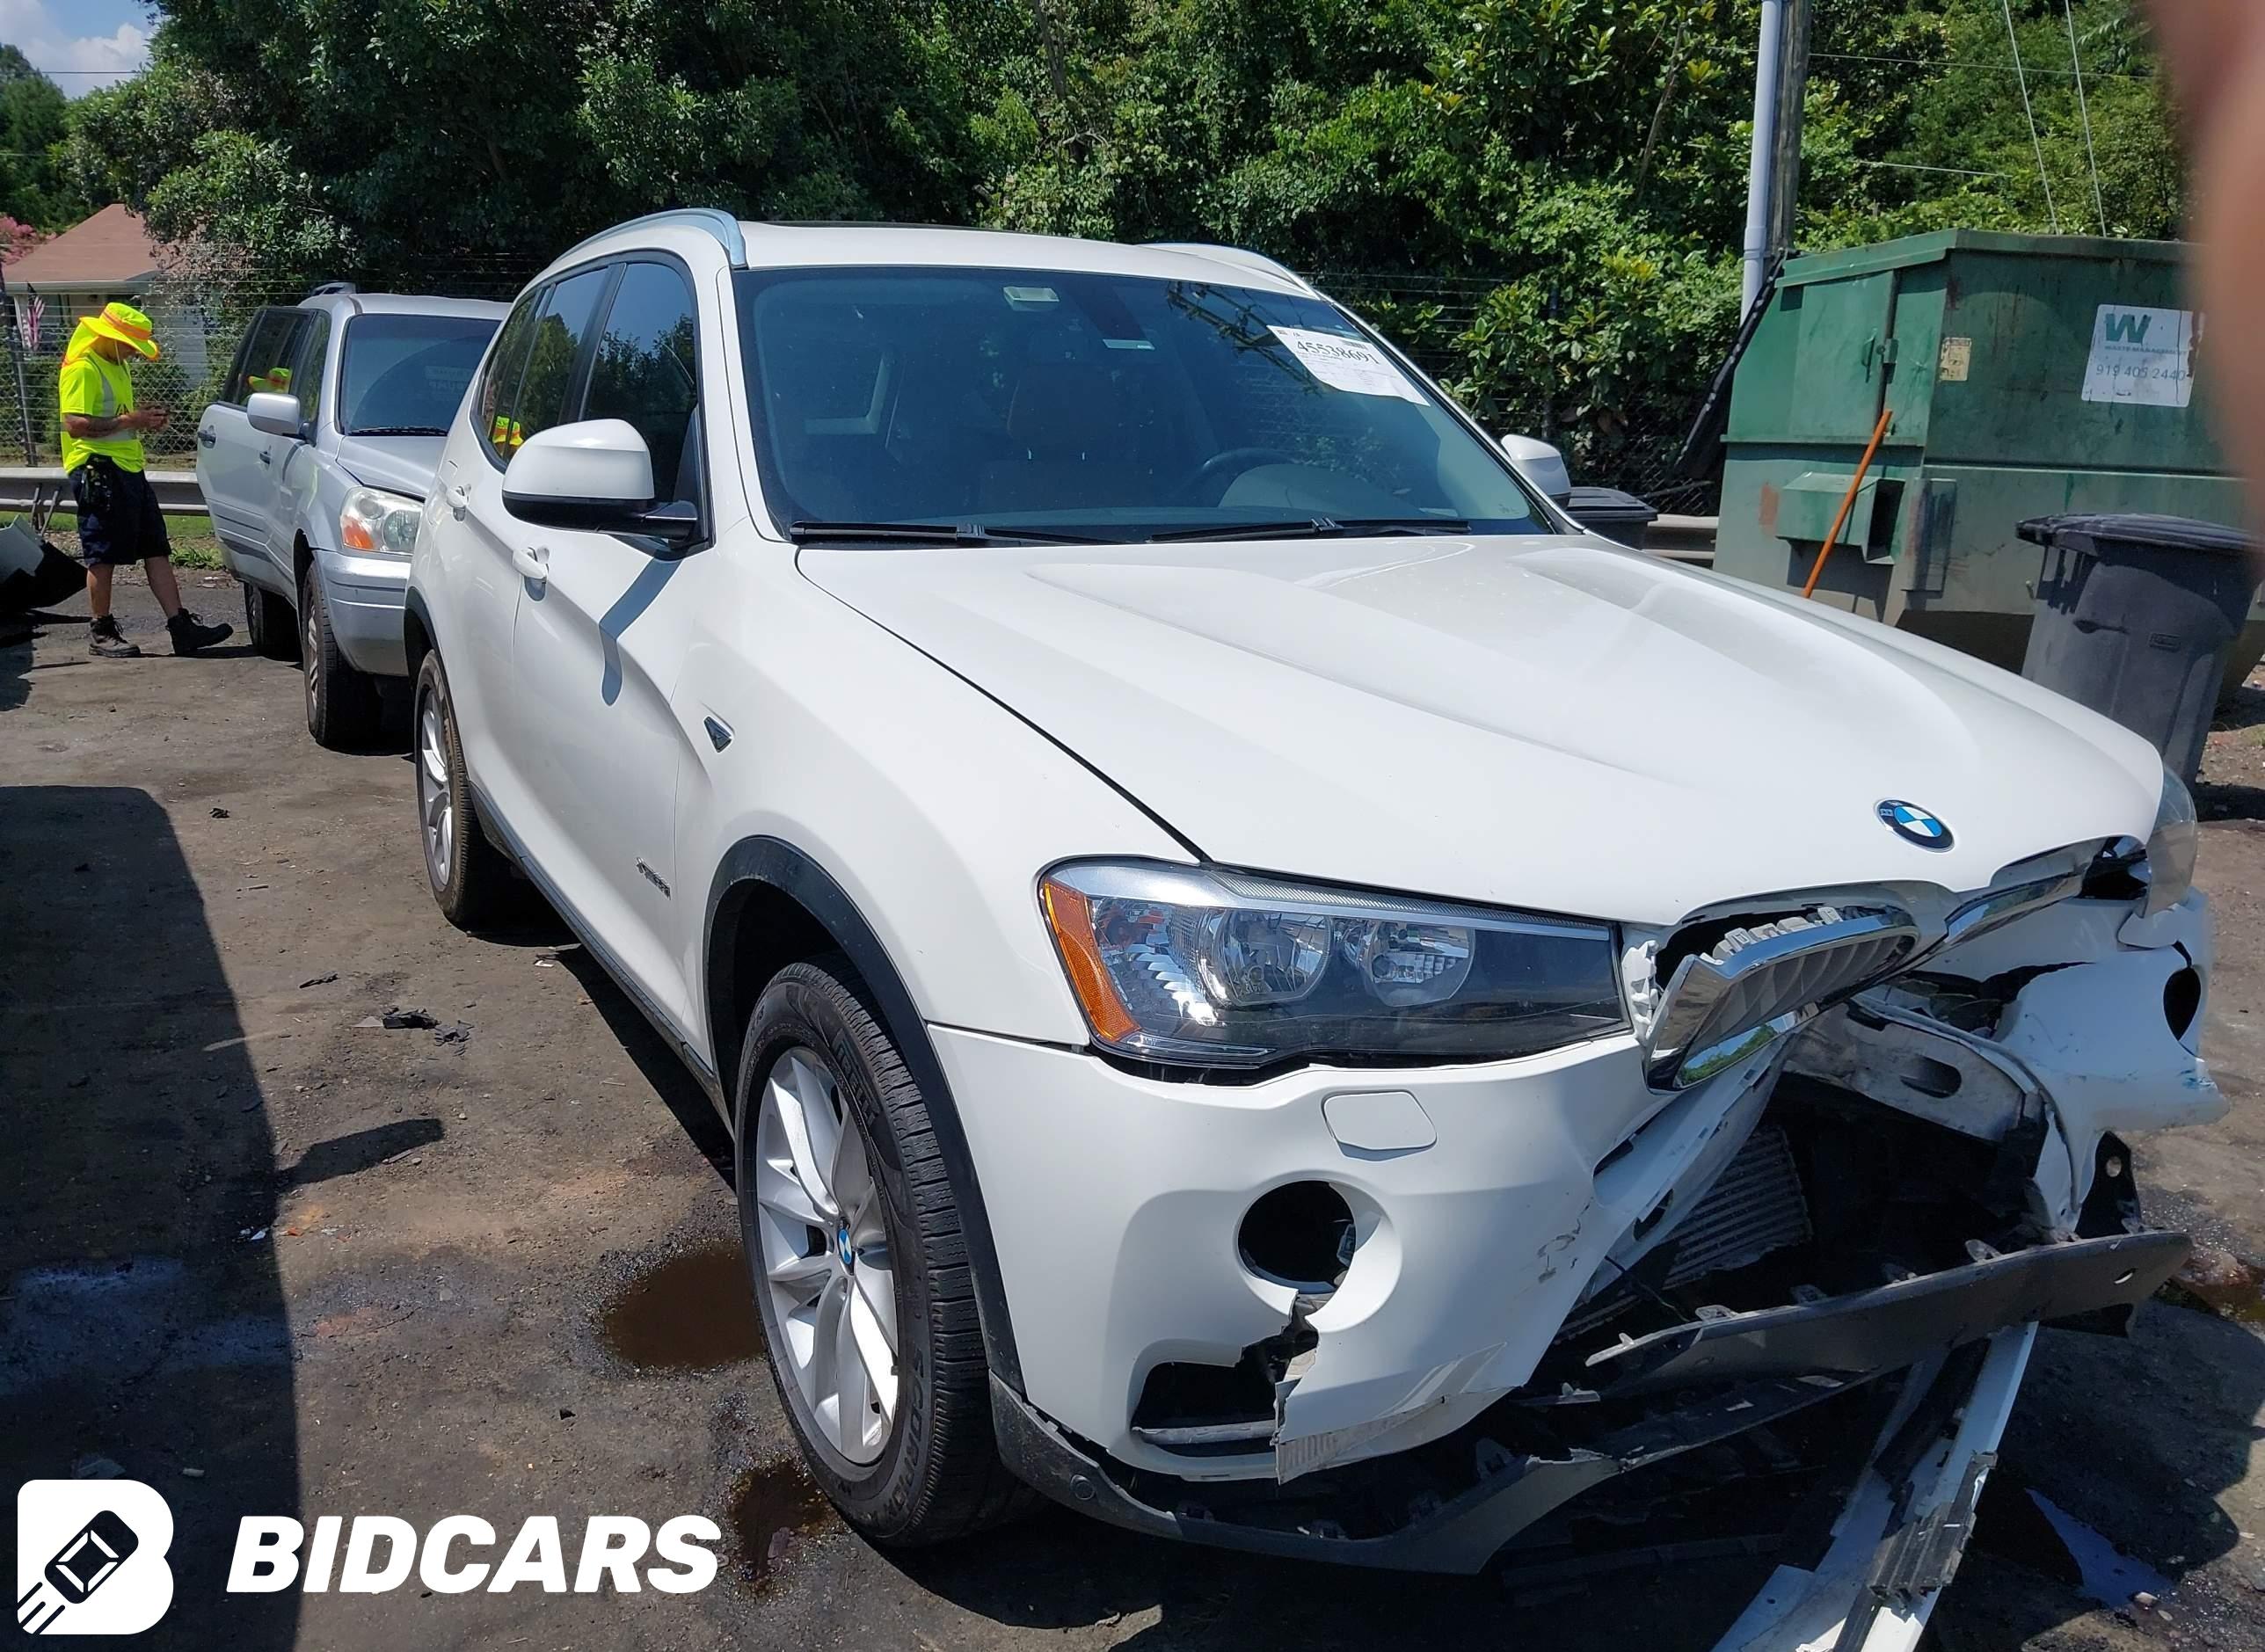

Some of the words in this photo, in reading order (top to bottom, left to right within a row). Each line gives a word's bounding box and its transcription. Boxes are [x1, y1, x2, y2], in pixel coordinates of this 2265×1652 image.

[2104, 313, 2152, 344] W
[1297, 340, 1380, 365] 45538691
[2096, 364, 2120, 376] 919
[2124, 366, 2148, 378] 405
[2152, 368, 2186, 381] 2440
